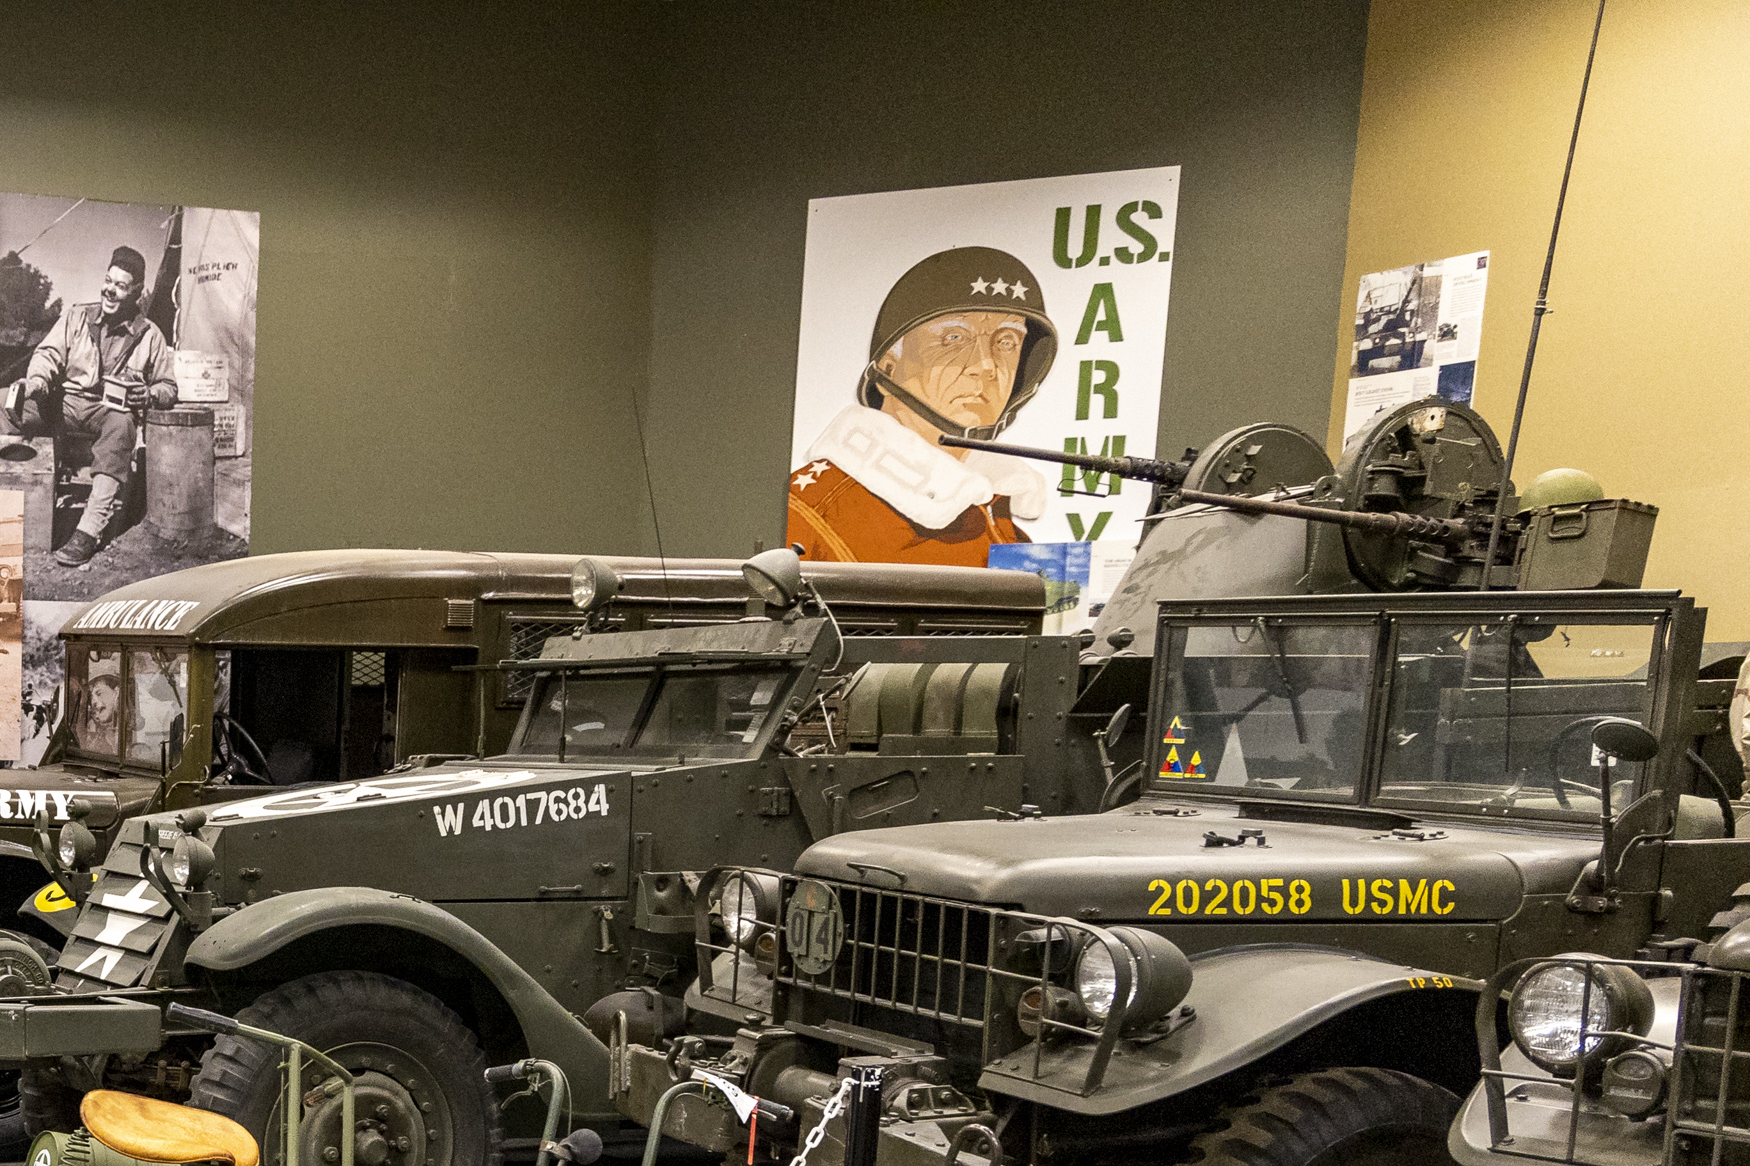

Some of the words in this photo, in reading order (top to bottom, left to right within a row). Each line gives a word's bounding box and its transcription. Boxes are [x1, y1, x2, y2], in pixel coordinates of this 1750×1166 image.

[1053, 200, 1171, 269] U.S.
[73, 599, 200, 631] AMBULANCE
[432, 802, 465, 837] W
[471, 783, 610, 832] 4017684
[1147, 878, 1312, 915] 202058
[1341, 878, 1456, 915] USMC
[1406, 977, 1426, 989] TP
[1432, 976, 1453, 989] 50
